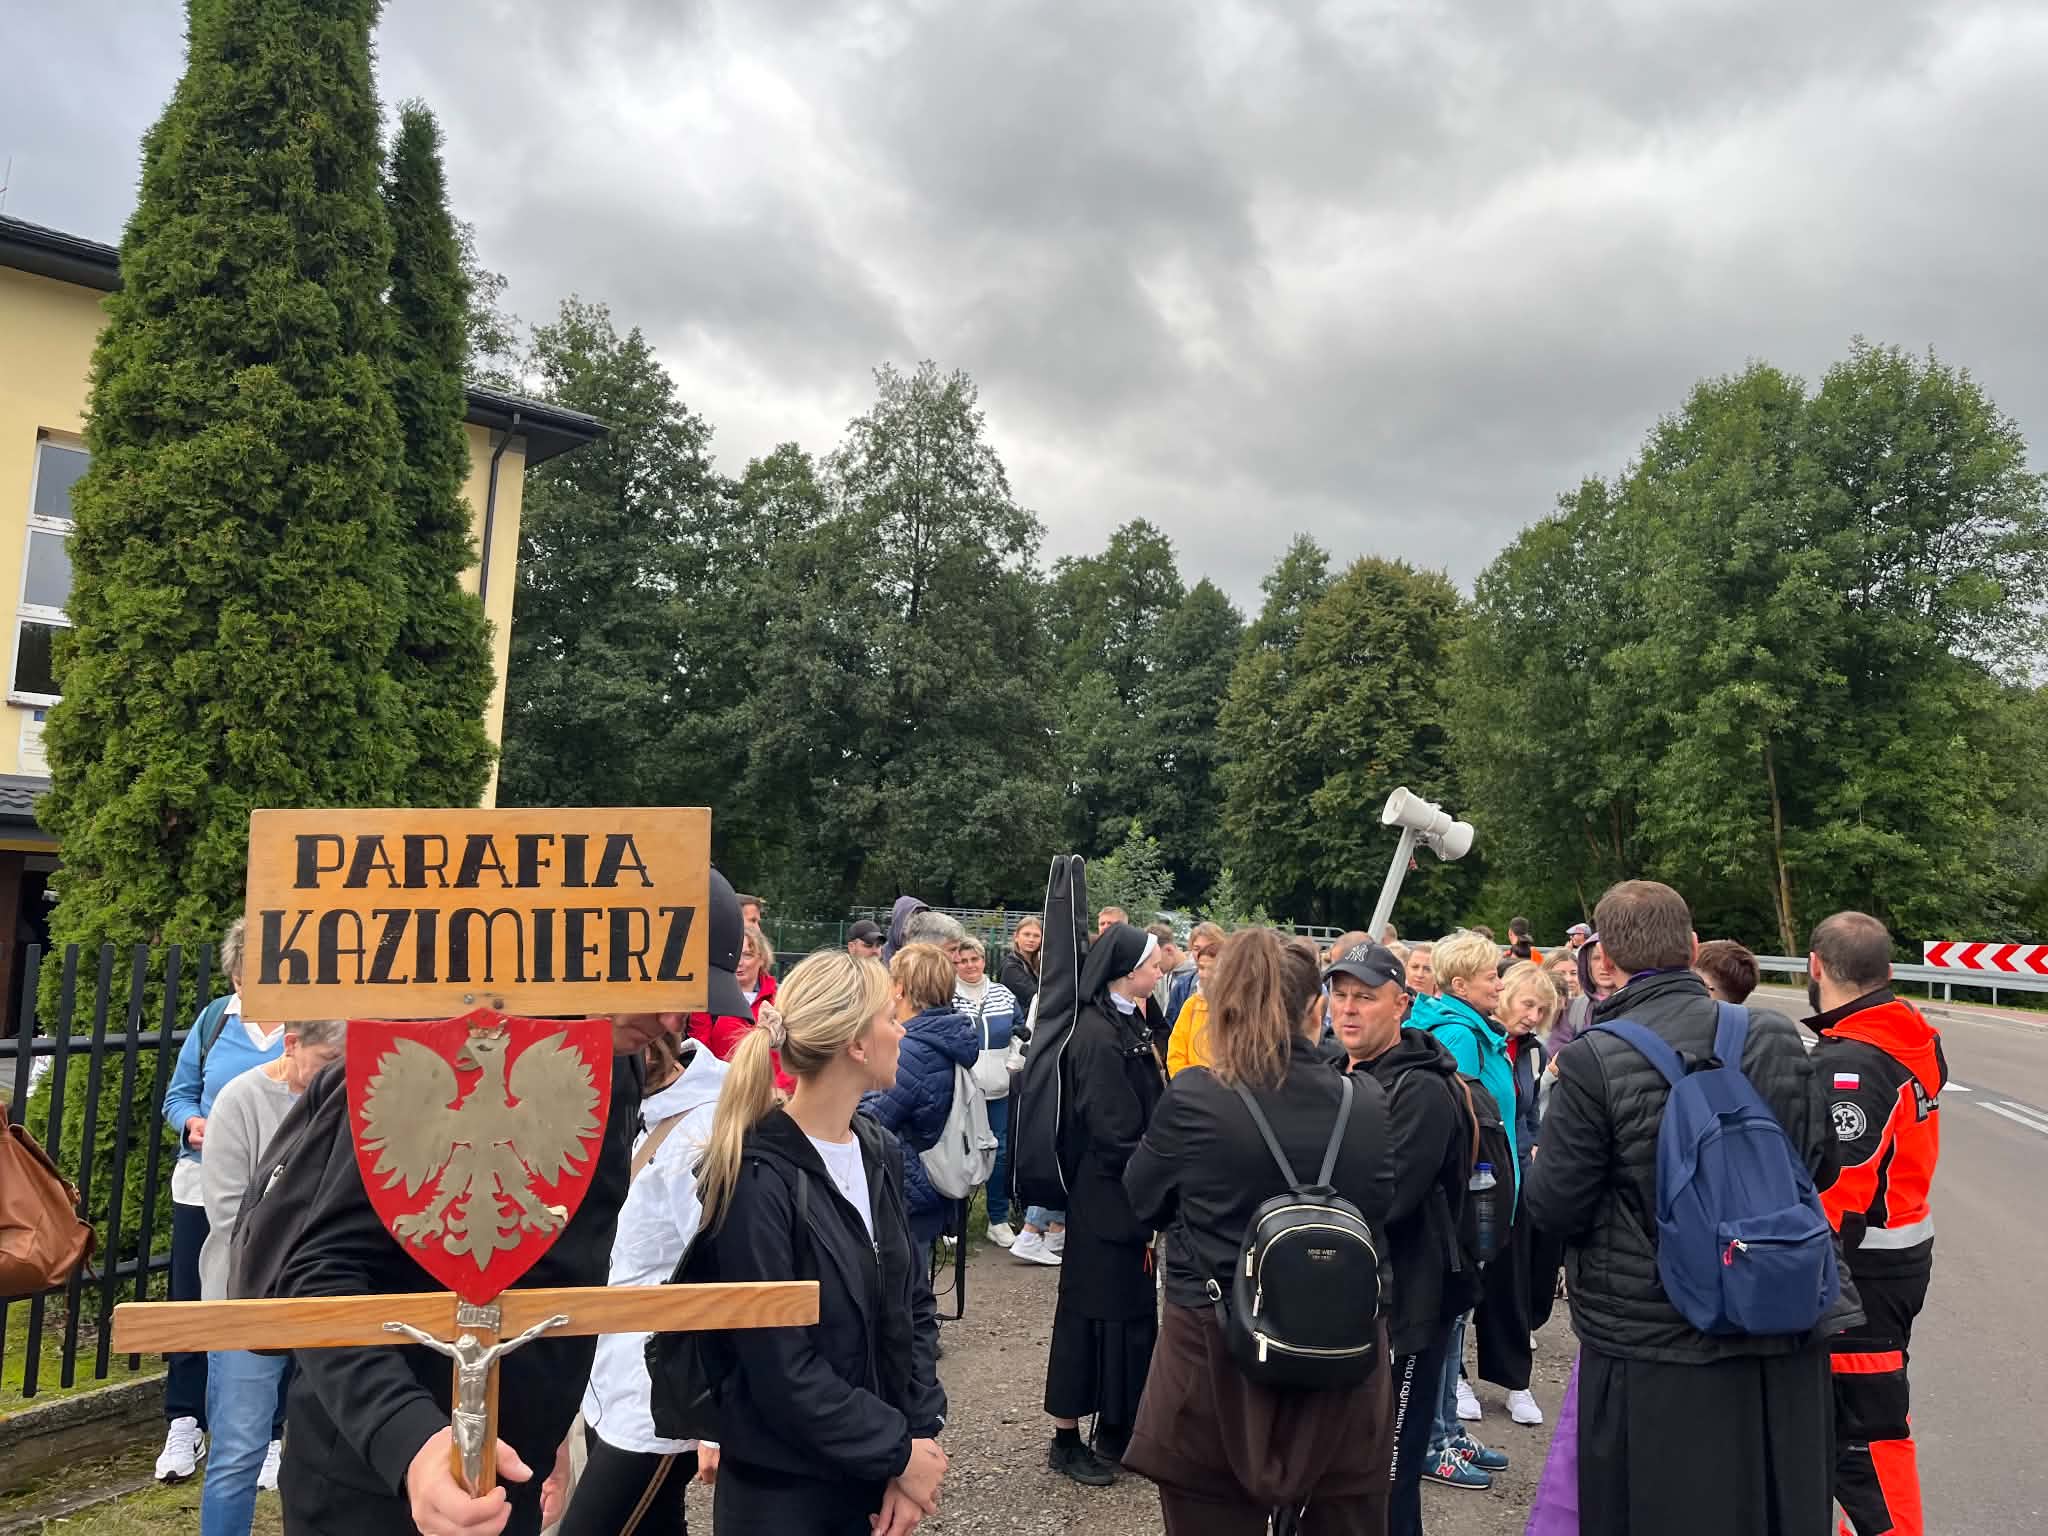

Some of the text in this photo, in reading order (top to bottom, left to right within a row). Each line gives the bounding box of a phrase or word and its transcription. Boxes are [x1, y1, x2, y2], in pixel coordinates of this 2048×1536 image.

[293, 833, 654, 889] PARAFIA
[257, 906, 696, 985] KAZIMIERZ
[1404, 1355, 1416, 1379] POLO
[1394, 1381, 1411, 1434] EQUIPMENT
[1436, 1464, 1455, 1477] N
